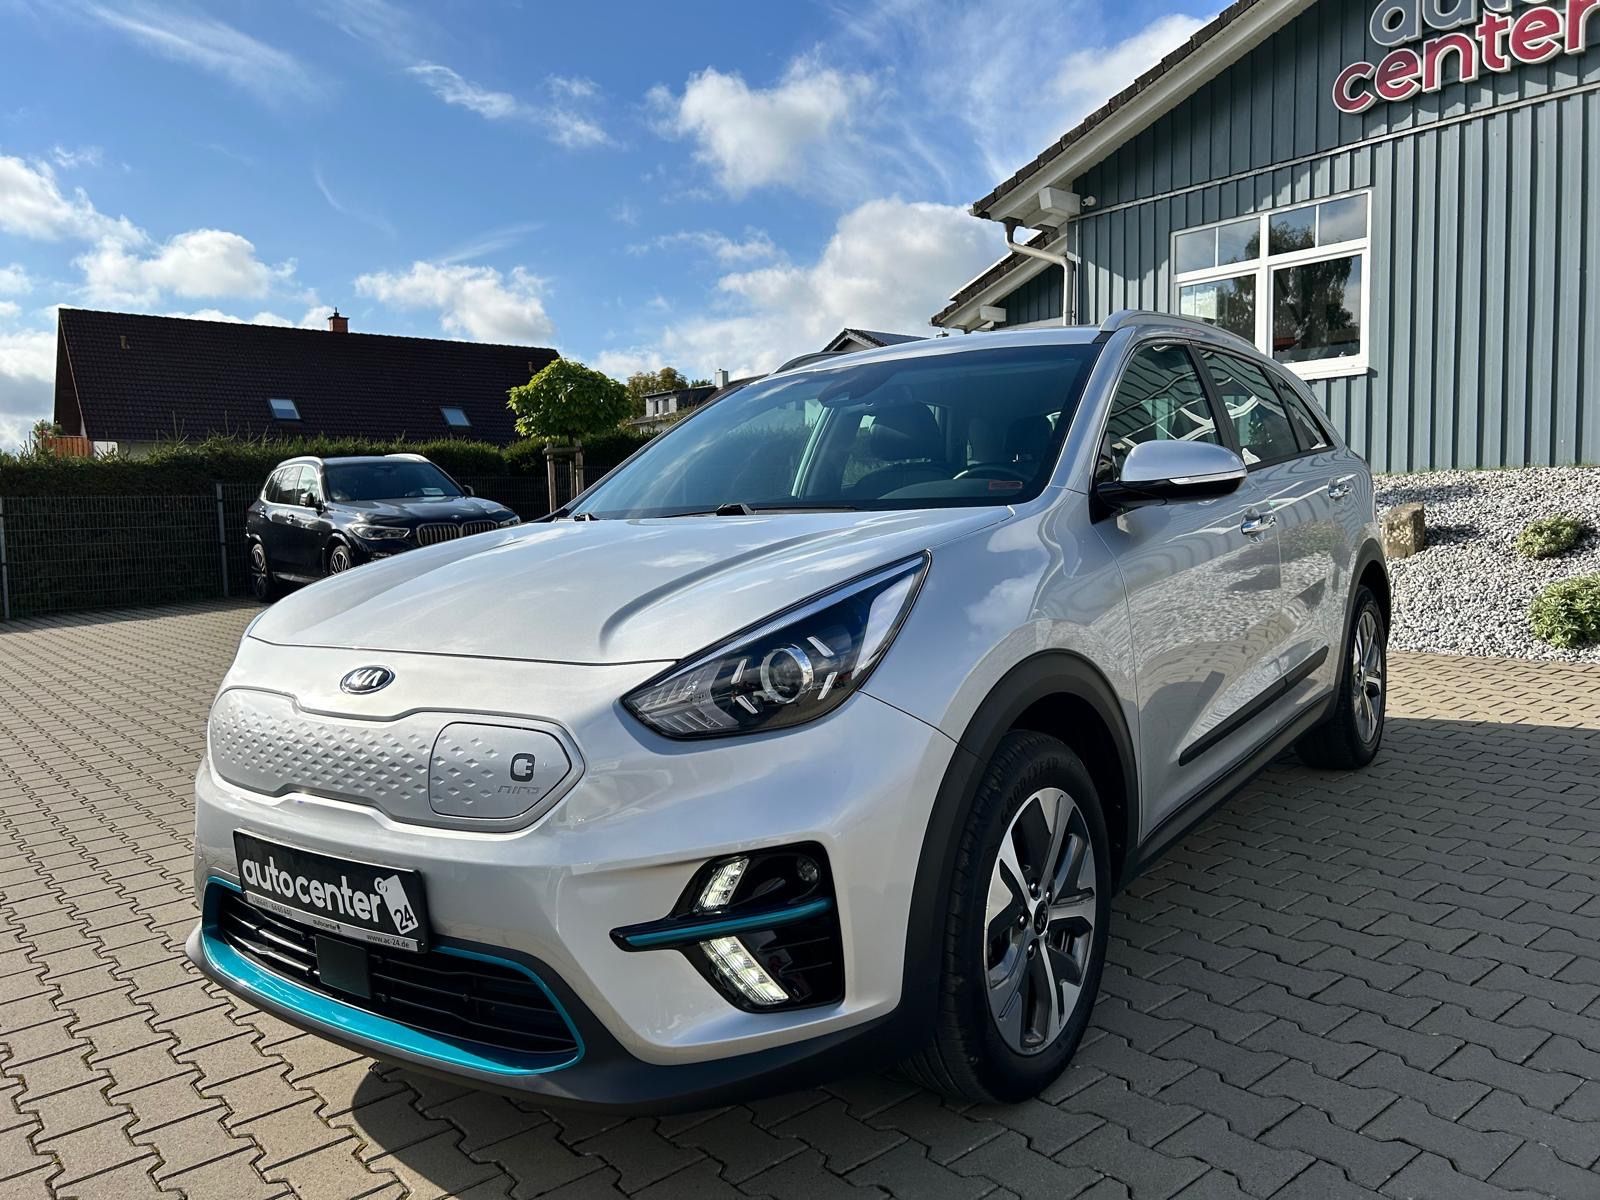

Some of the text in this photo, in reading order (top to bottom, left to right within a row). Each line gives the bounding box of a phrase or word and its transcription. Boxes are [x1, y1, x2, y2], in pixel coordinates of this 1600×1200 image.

[1370, 0, 1548, 46] au
[1332, 0, 1600, 113] center
[242, 855, 381, 923] autocenter
[393, 904, 416, 930] 24
[366, 934, 410, 949] www.ac-24.de
